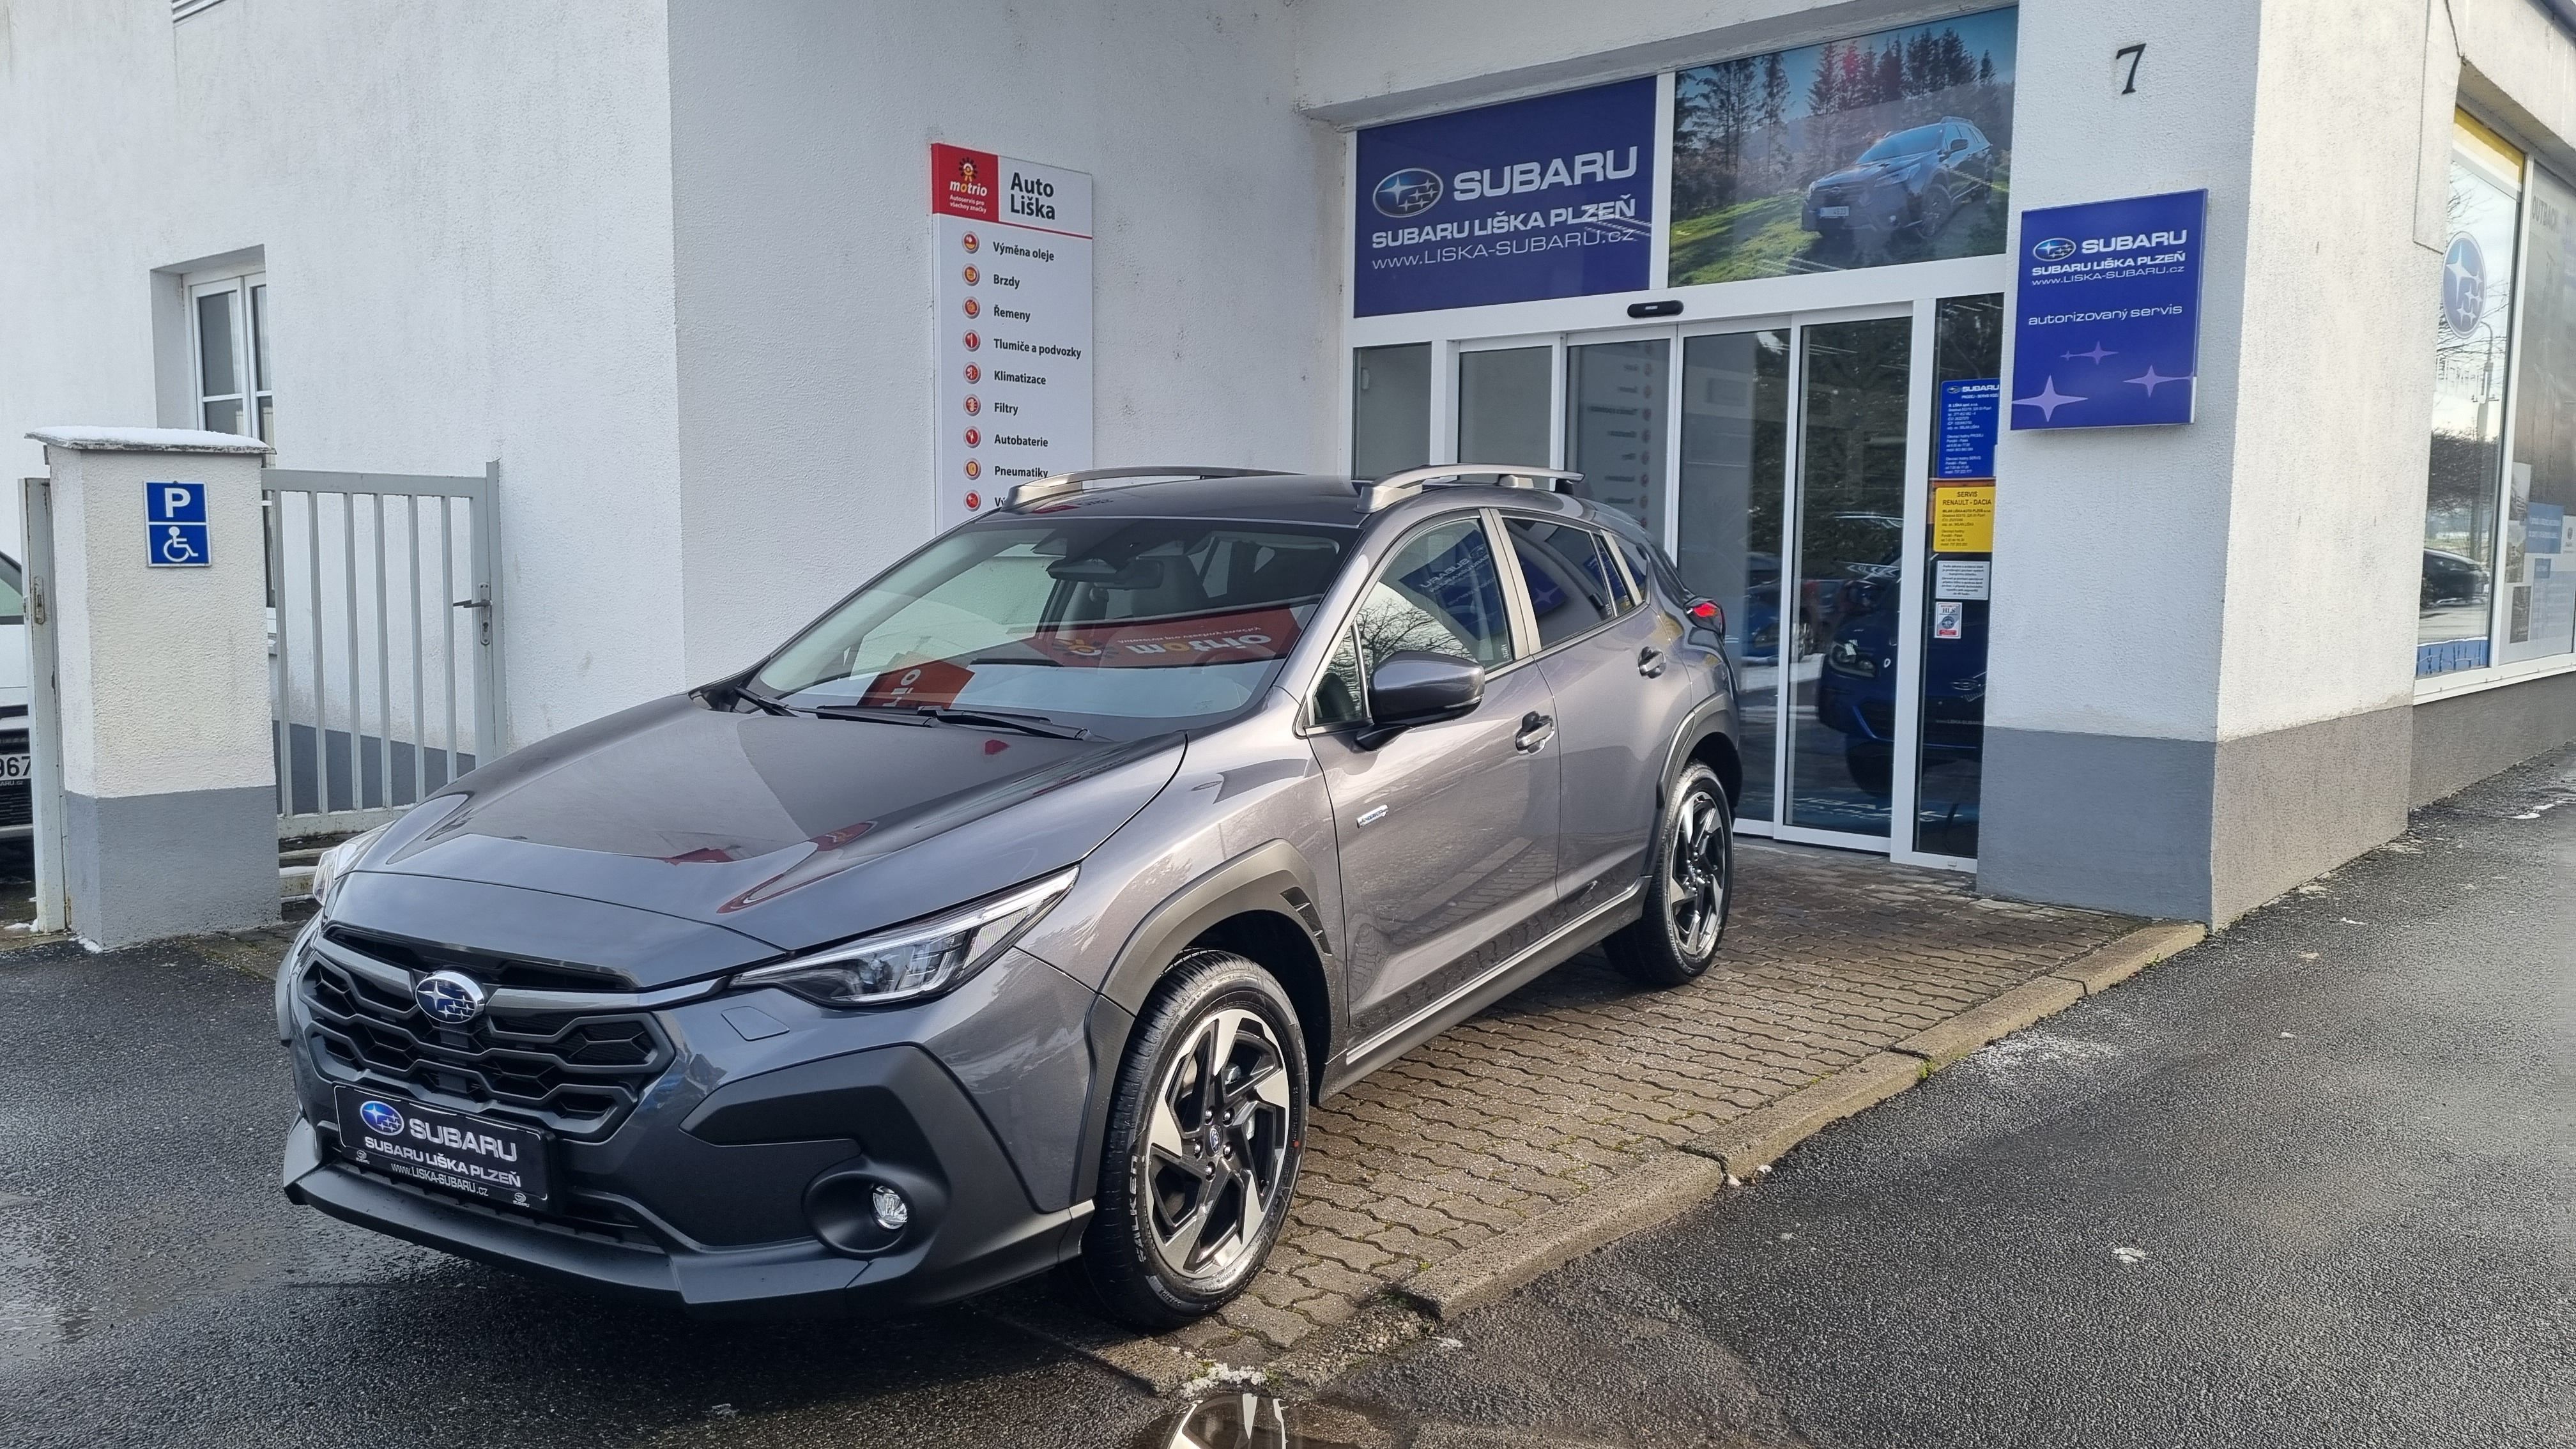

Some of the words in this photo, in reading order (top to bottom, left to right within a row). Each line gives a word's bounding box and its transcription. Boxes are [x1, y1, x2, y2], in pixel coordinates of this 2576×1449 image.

[2116, 43, 2147, 95] 7
[1010, 172, 1054, 197] Auto
[1453, 146, 1637, 201] SUBARU
[949, 180, 988, 197] motrio
[949, 194, 975, 204] Autoservis
[950, 201, 969, 211] všechny
[970, 204, 986, 214] značky
[1010, 194, 1055, 220] Liška
[1372, 220, 1469, 249] SUBARU
[1474, 211, 1545, 236] LIŠKA
[1550, 194, 1636, 227] PLZEŇ
[993, 241, 1030, 257] Výměna
[1032, 250, 1054, 262] oleje
[1372, 229, 1635, 270] www.LISKA-SUBARU.cz
[2082, 229, 2187, 254] SUBARU
[2032, 262, 2091, 276] SUBARU
[2093, 258, 2135, 270] LIŠKA
[2137, 251, 2186, 266] PLZEŇ
[993, 274, 1020, 289] Brzdy
[2032, 266, 2184, 286] www.LISKA-SUBARU.cz
[993, 305, 1031, 322] Řemeny
[2028, 309, 2128, 325] autorizovaný
[2130, 303, 2182, 318] servis
[993, 339, 1029, 352] Tlumiče
[1039, 345, 1081, 359] podvozky
[994, 371, 1046, 385] Klimatizace
[994, 402, 1018, 416] Filtry
[994, 434, 1048, 447] Autobaterie
[995, 466, 1048, 479] Pneumatiky
[164, 487, 190, 518] P
[409, 1118, 518, 1162] SUBARU
[365, 1136, 424, 1163] SUBARU
[425, 1153, 468, 1174] LIŠKA
[470, 1164, 521, 1188] PLZEŇ
[390, 1163, 489, 1197] www.LISKA-SUBARU.cz
